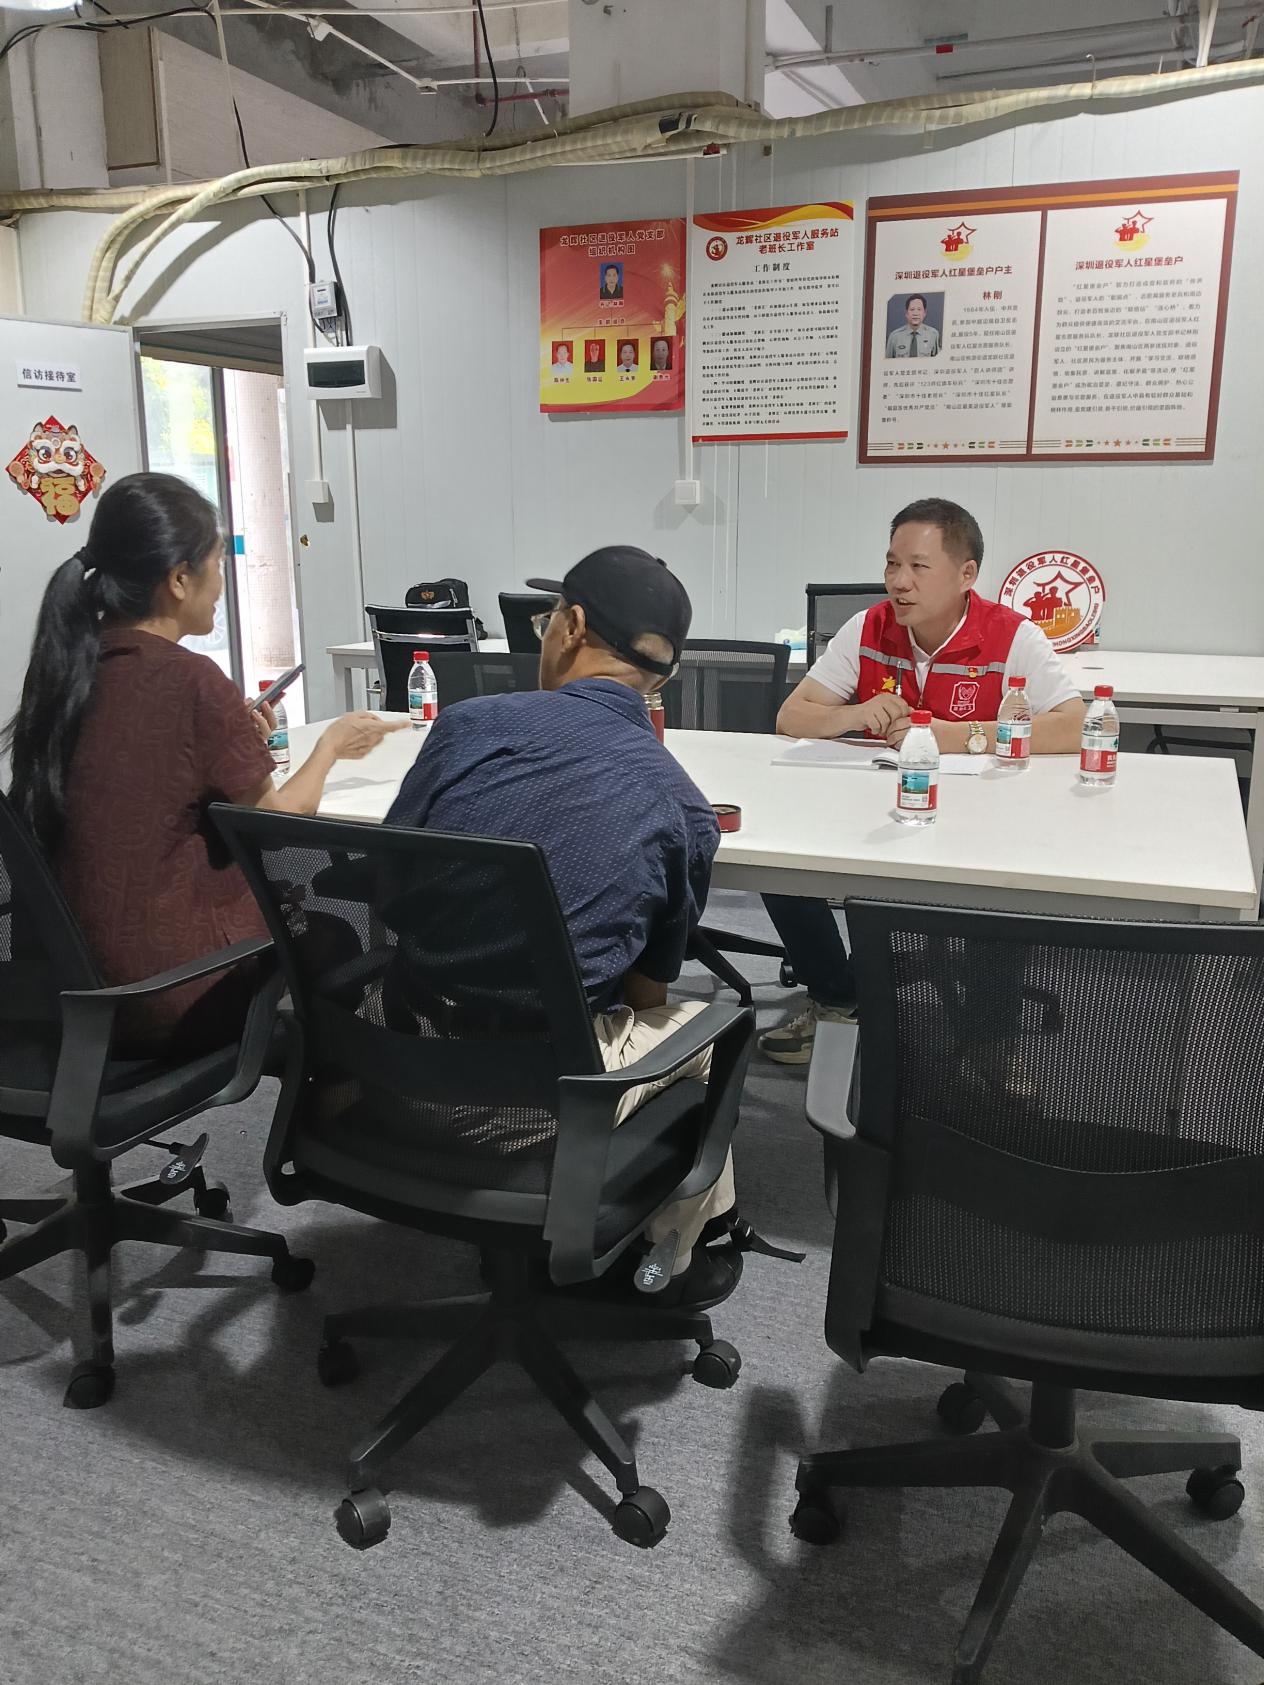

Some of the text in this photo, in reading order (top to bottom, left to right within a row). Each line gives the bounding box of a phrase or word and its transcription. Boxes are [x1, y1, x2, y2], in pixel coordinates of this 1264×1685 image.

[736, 228, 839, 245] 龙辉社区退役军人服务站
[588, 244, 636, 257] 组织机构图
[758, 241, 815, 255] 老班长工作室
[754, 262, 791, 273] 工作制度
[1075, 256, 1184, 271] 深圳退役军人红星堡垒户
[894, 265, 1013, 280] 深圳退役军人红星堡垒户户主
[22, 367, 77, 383] 信访接待室
